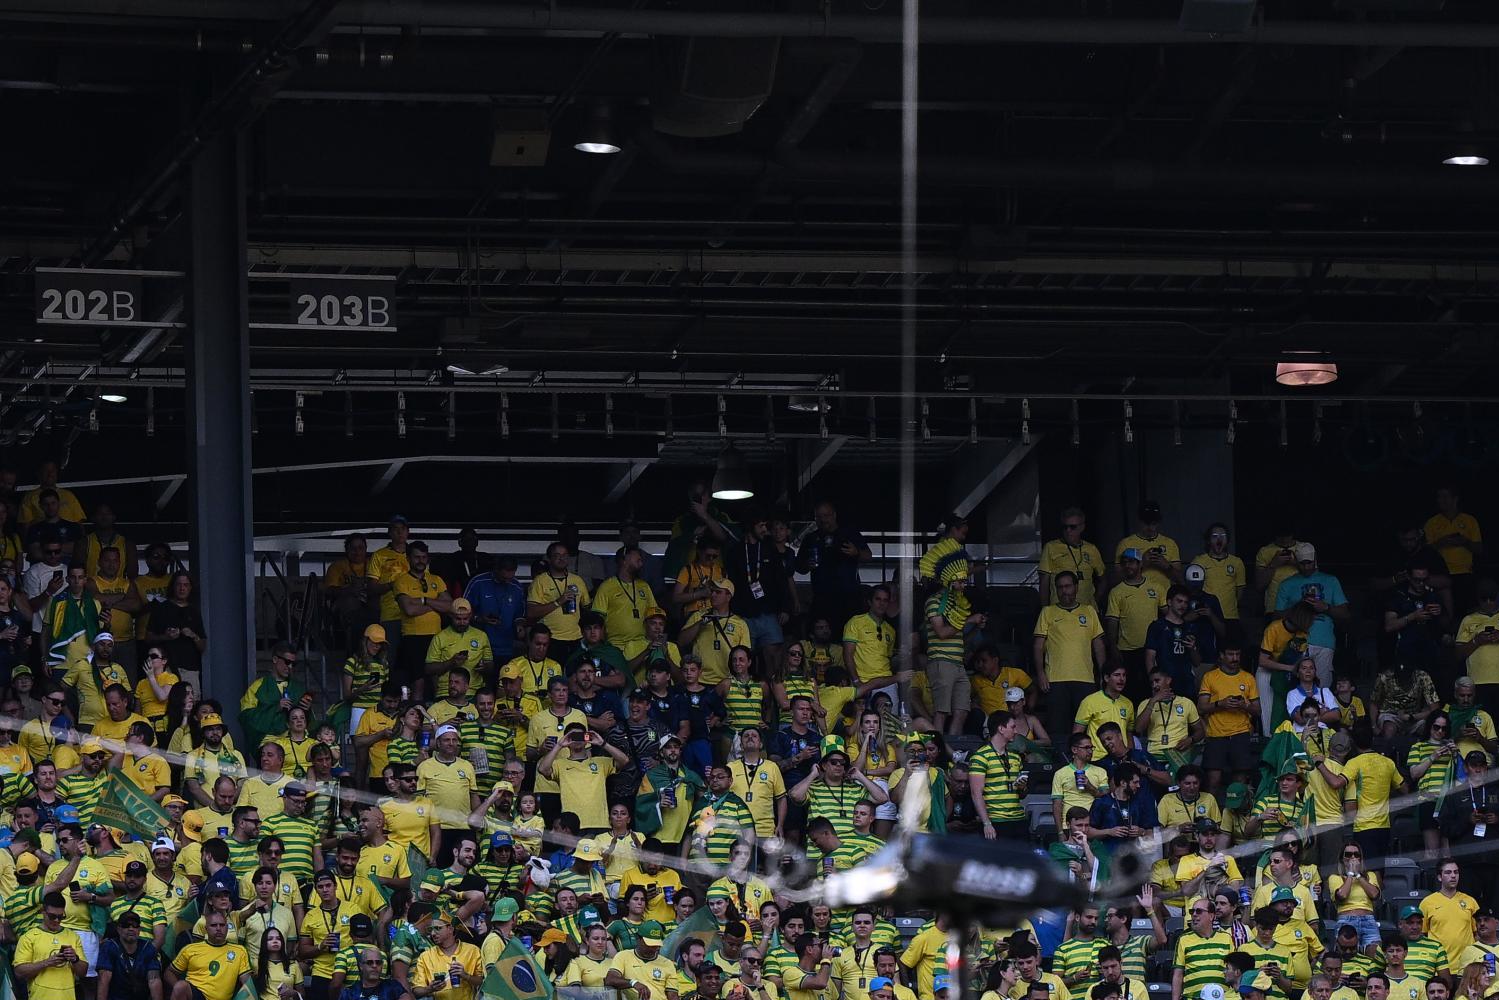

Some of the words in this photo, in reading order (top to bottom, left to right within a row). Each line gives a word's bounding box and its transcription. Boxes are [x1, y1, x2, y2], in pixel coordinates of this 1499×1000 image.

[41, 288, 136, 321] 202B
[297, 294, 390, 327] 203B
[208, 960, 221, 977] 9
